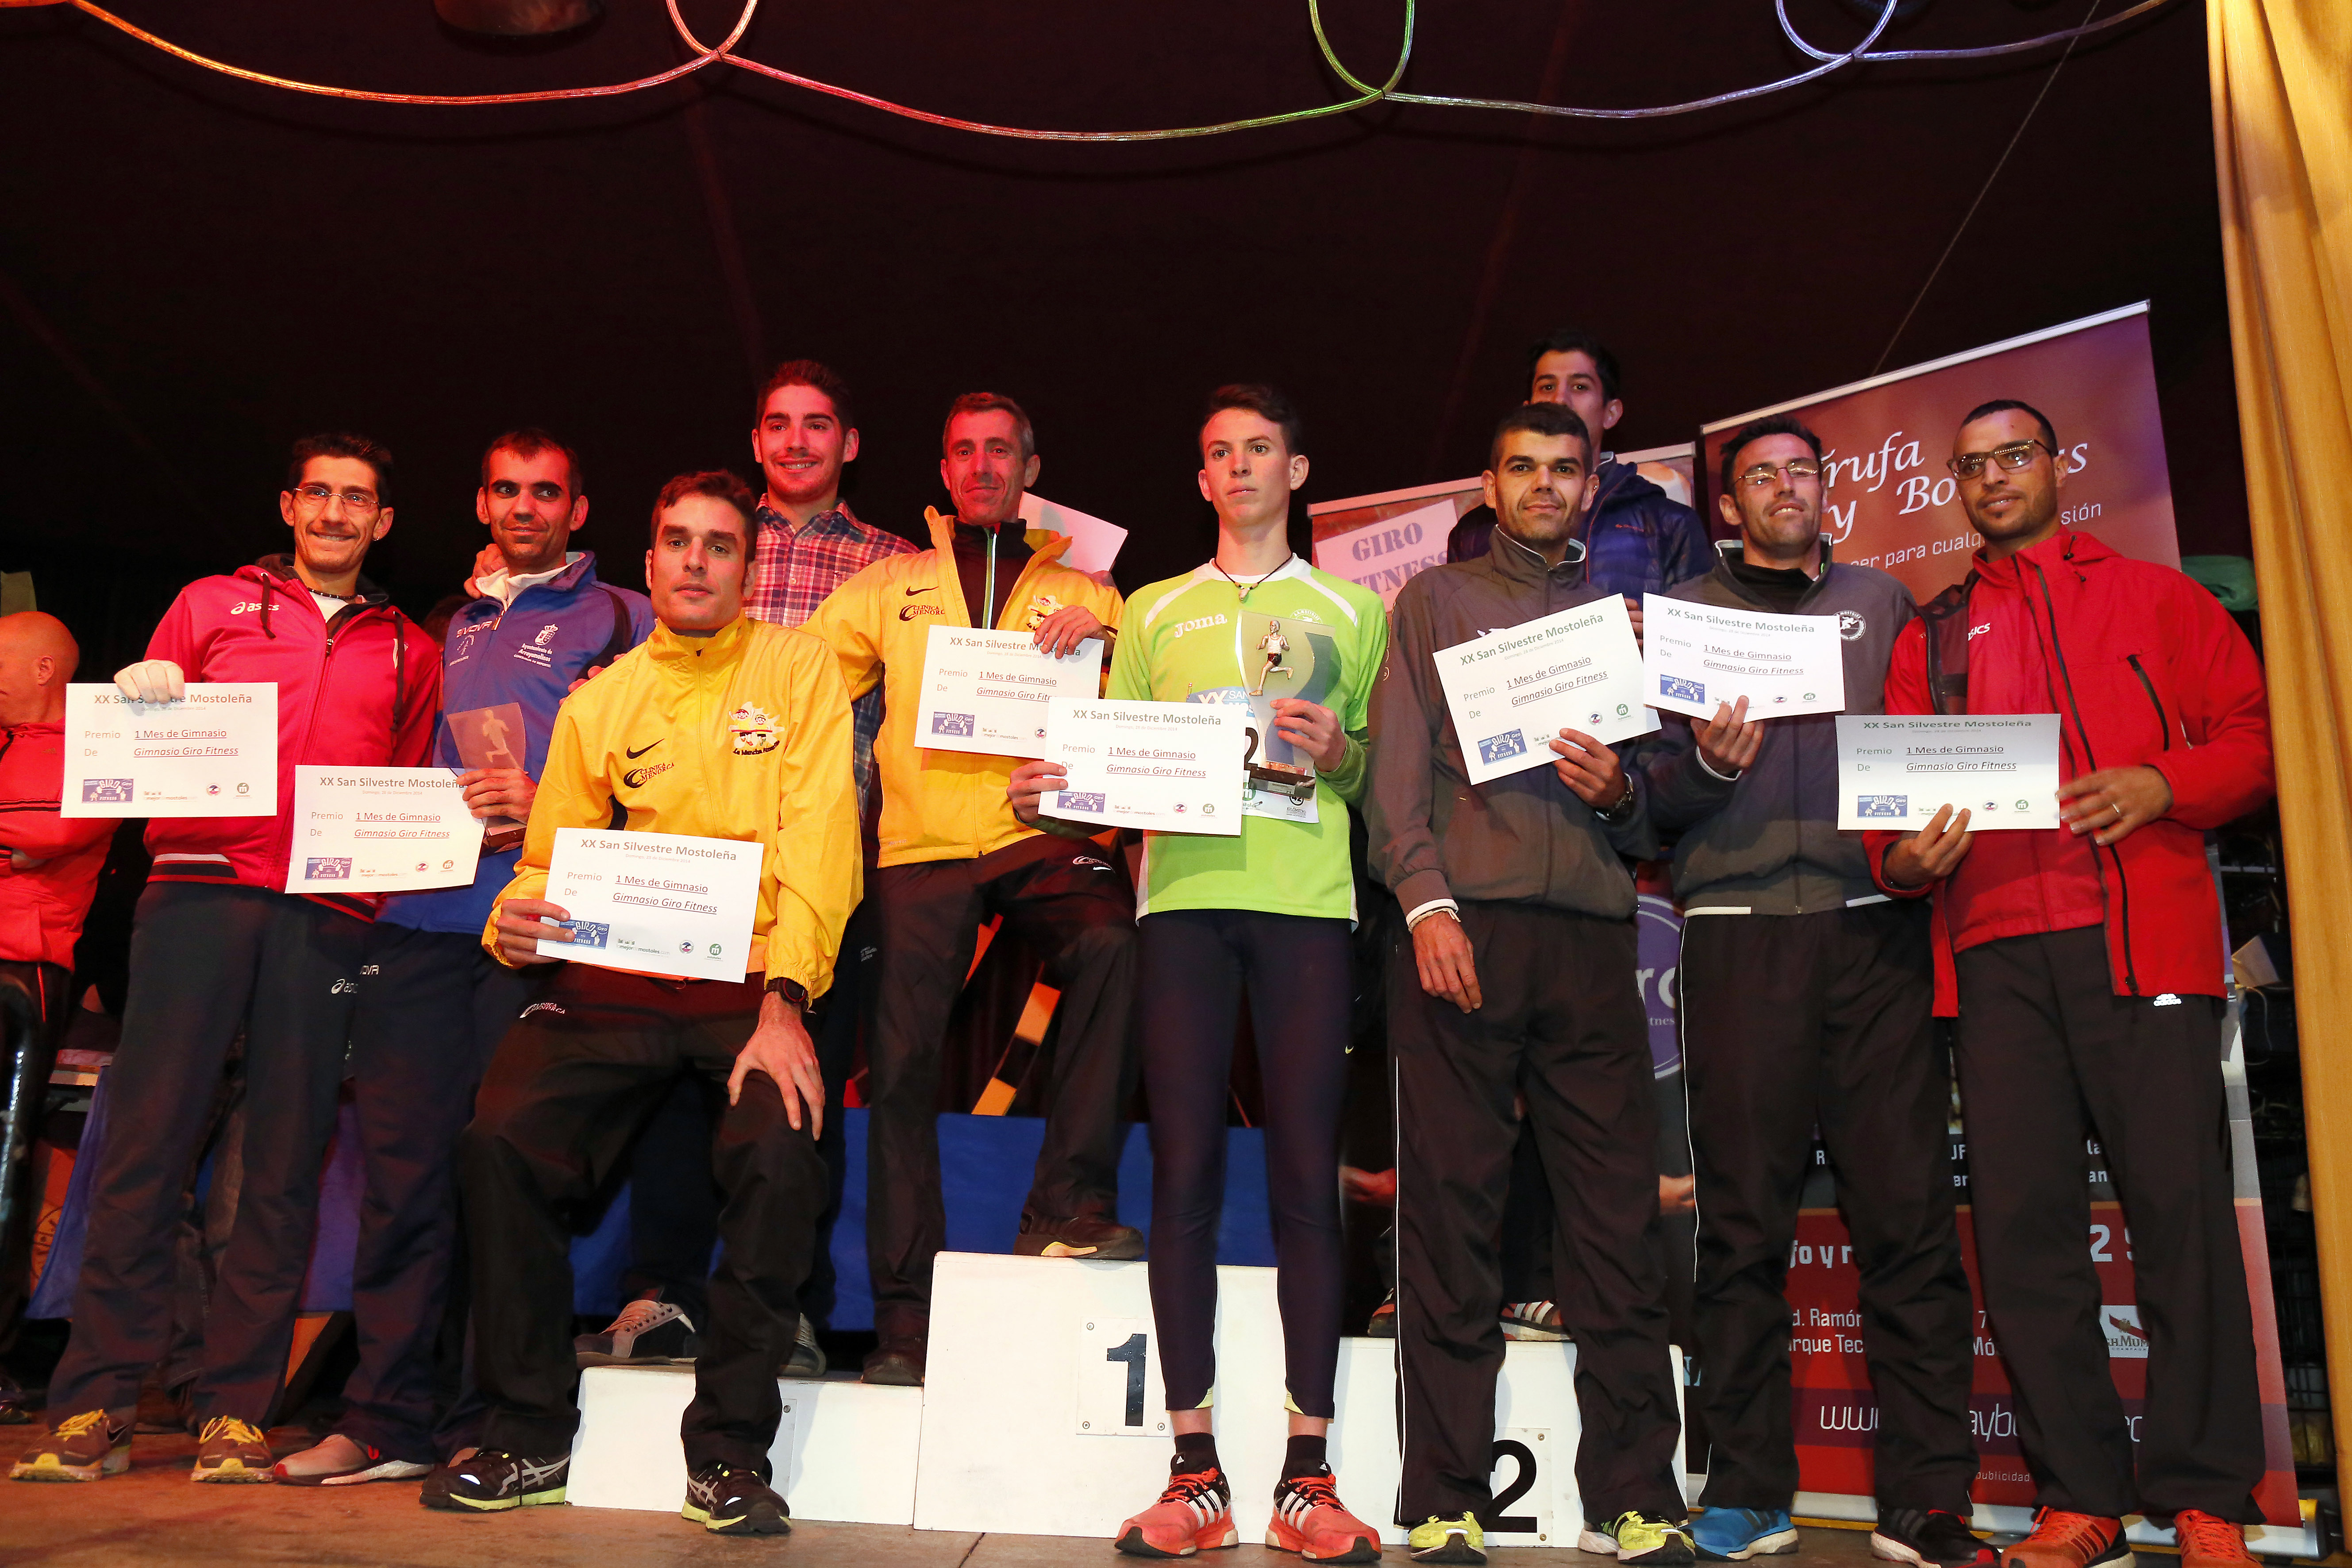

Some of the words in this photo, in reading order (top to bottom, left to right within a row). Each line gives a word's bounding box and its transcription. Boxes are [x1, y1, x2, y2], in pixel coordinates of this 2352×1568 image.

[1821, 431, 1925, 493] rufa
[1828, 500, 1857, 544] y
[2061, 503, 2101, 525] sión
[1353, 523, 1423, 561] GIRO
[1886, 545, 1925, 569] para
[1932, 532, 1981, 555] cualq
[1174, 613, 1228, 638] Joma
[1668, 608, 1681, 617] XX
[1684, 612, 1702, 621] San
[1706, 615, 1751, 629] Silvestre
[1755, 622, 1814, 632] Mostoleña
[966, 639, 982, 647] San
[986, 640, 1026, 650] Silvestre
[1460, 654, 1475, 666] XX
[1477, 647, 1496, 661] San
[1498, 633, 1543, 653] Silvestre
[1546, 614, 1603, 638] Mostoleña
[1660, 636, 1691, 647] Premio
[1712, 646, 1731, 655] Mes
[1748, 651, 1791, 660] Gimnasio
[1660, 649, 1672, 658] De
[1704, 659, 1746, 673] Gimnasio
[1019, 675, 1057, 685] Gimnasio
[1463, 686, 1495, 701] Premio
[1514, 674, 1533, 686] Mes
[1536, 669, 1547, 679] de
[1549, 656, 1591, 675] Gimnasio
[95, 695, 109, 704] XX
[190, 694, 251, 703] Mostoleña
[977, 687, 1015, 697] Gimnasio
[1018, 691, 1035, 699] Giro
[1470, 709, 1481, 719] De
[1512, 687, 1552, 705] Gimnasio
[1555, 680, 1574, 692] Giro
[1577, 670, 1607, 686] Fitness
[1073, 710, 1087, 718] XX
[1091, 711, 1109, 720] San
[1113, 712, 1159, 722] Silvestre
[1163, 714, 1221, 724] Mostoleña
[1062, 744, 1095, 753] Premio
[1153, 750, 1195, 759] Gimnasio
[640, 763, 665, 774] CLINICA
[641, 763, 674, 781] MENORCA
[1107, 764, 1150, 774] Gimnasio
[1175, 768, 1206, 776] Fitness
[1906, 762, 1953, 771] Gimnasio
[320, 778, 334, 786] XX
[338, 778, 356, 786] San
[360, 778, 404, 787] Silvestre
[599, 840, 620, 849] San
[624, 842, 672, 854] Silvestre
[676, 847, 736, 860] Mostoleña
[567, 872, 602, 881] Premio
[625, 876, 645, 885] Mes
[648, 878, 660, 887] de
[663, 880, 708, 893] Gimnasio
[613, 893, 658, 905] Gimnasio
[662, 899, 681, 908] Giro
[685, 902, 718, 913] Fitness
[1107, 1333, 1147, 1426] 1
[1482, 1440, 1537, 1533] 2
